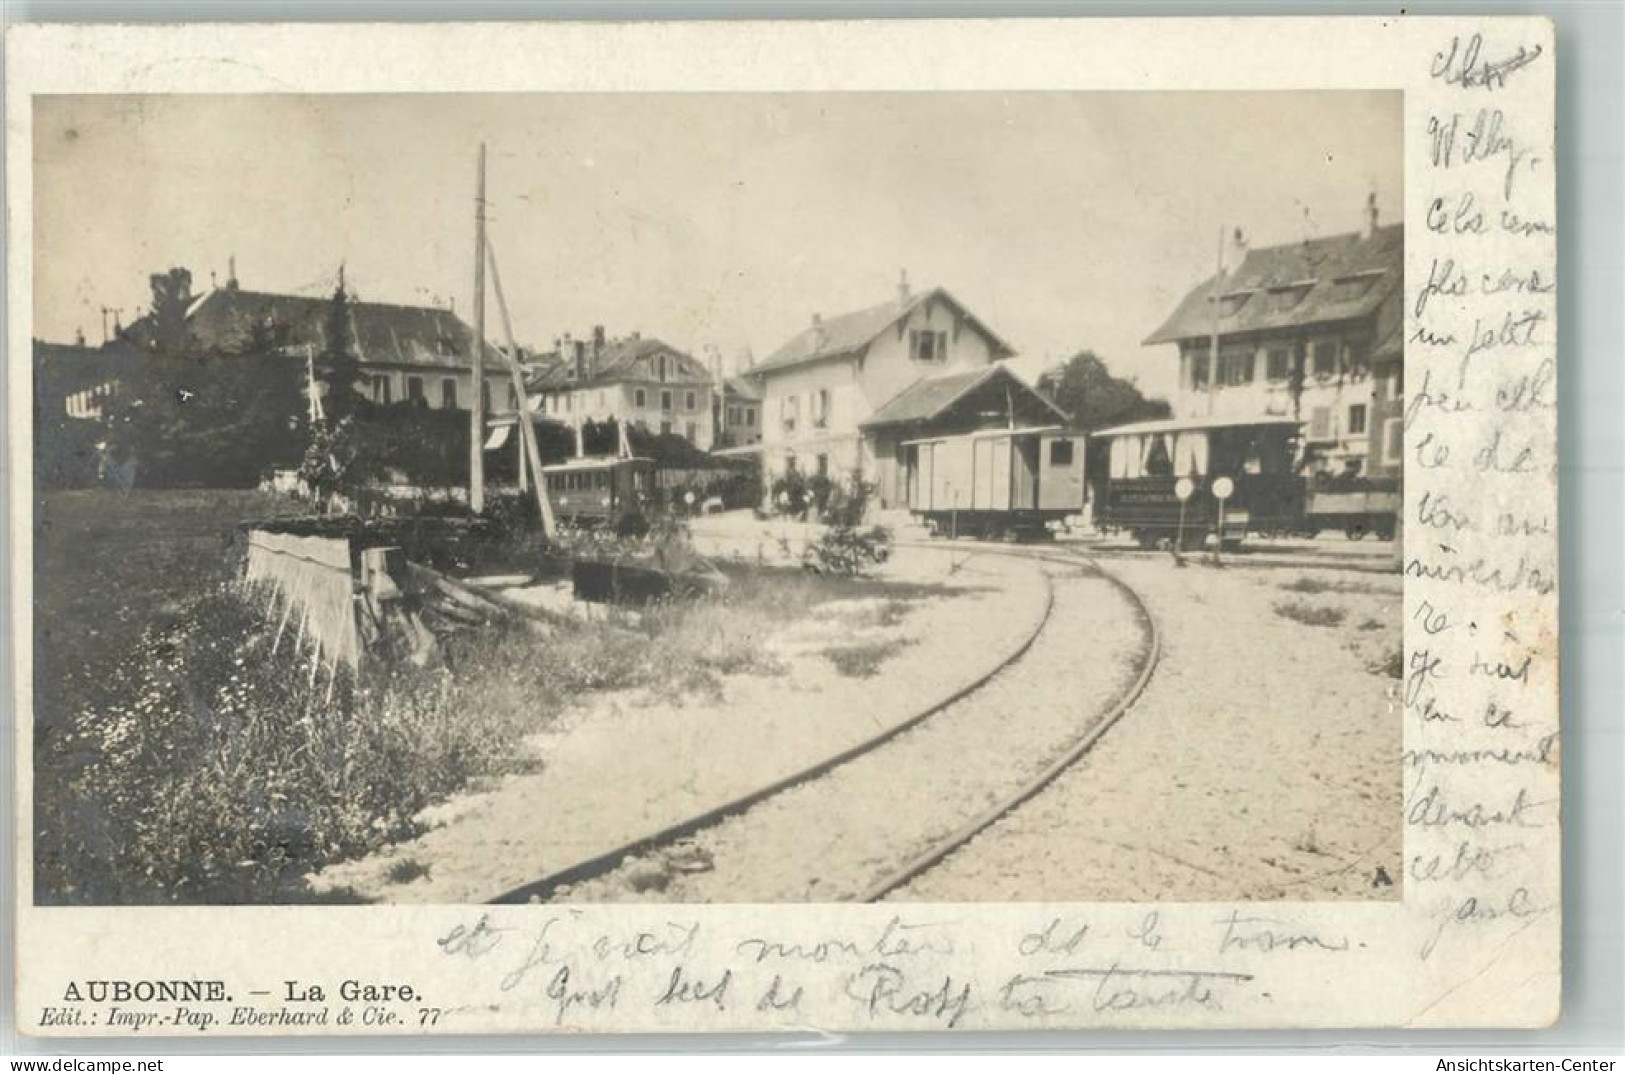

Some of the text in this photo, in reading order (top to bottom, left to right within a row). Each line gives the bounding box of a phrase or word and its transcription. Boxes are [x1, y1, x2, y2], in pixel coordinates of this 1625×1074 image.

[63, 980, 234, 1002] AUBONNE.
[284, 980, 325, 1002] La
[340, 980, 423, 1002] Gare.
[39, 1006, 97, 1026] Edit.:
[108, 1006, 219, 1030] Impr.-Pap.
[228, 1006, 328, 1026] Eberhard
[336, 1008, 354, 1026] &
